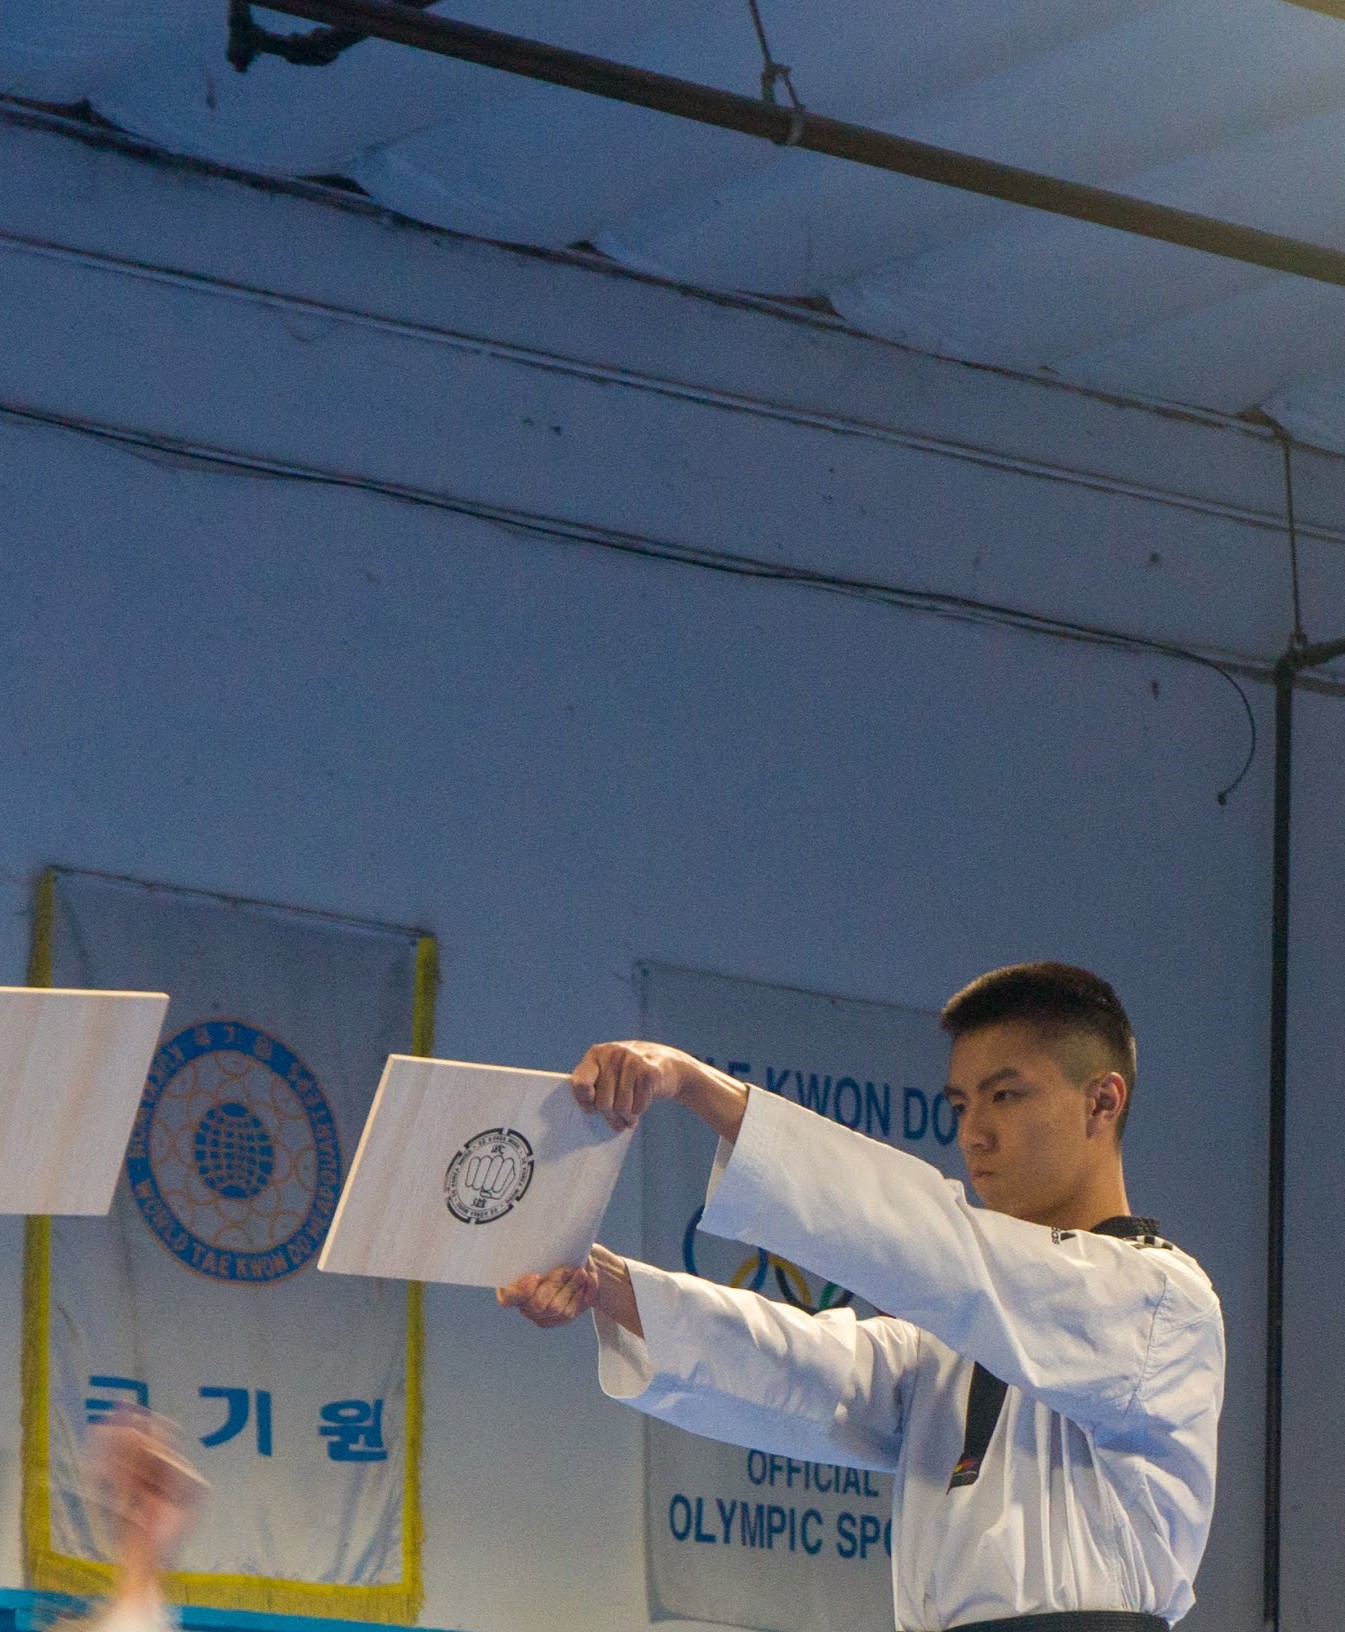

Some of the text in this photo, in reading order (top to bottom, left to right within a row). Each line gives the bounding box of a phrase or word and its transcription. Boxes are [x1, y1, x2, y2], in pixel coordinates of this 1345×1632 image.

[767, 1065, 891, 1136] KWON
[747, 1449, 879, 1497] OFFICIAL
[669, 1494, 824, 1556] OLYMPIC
